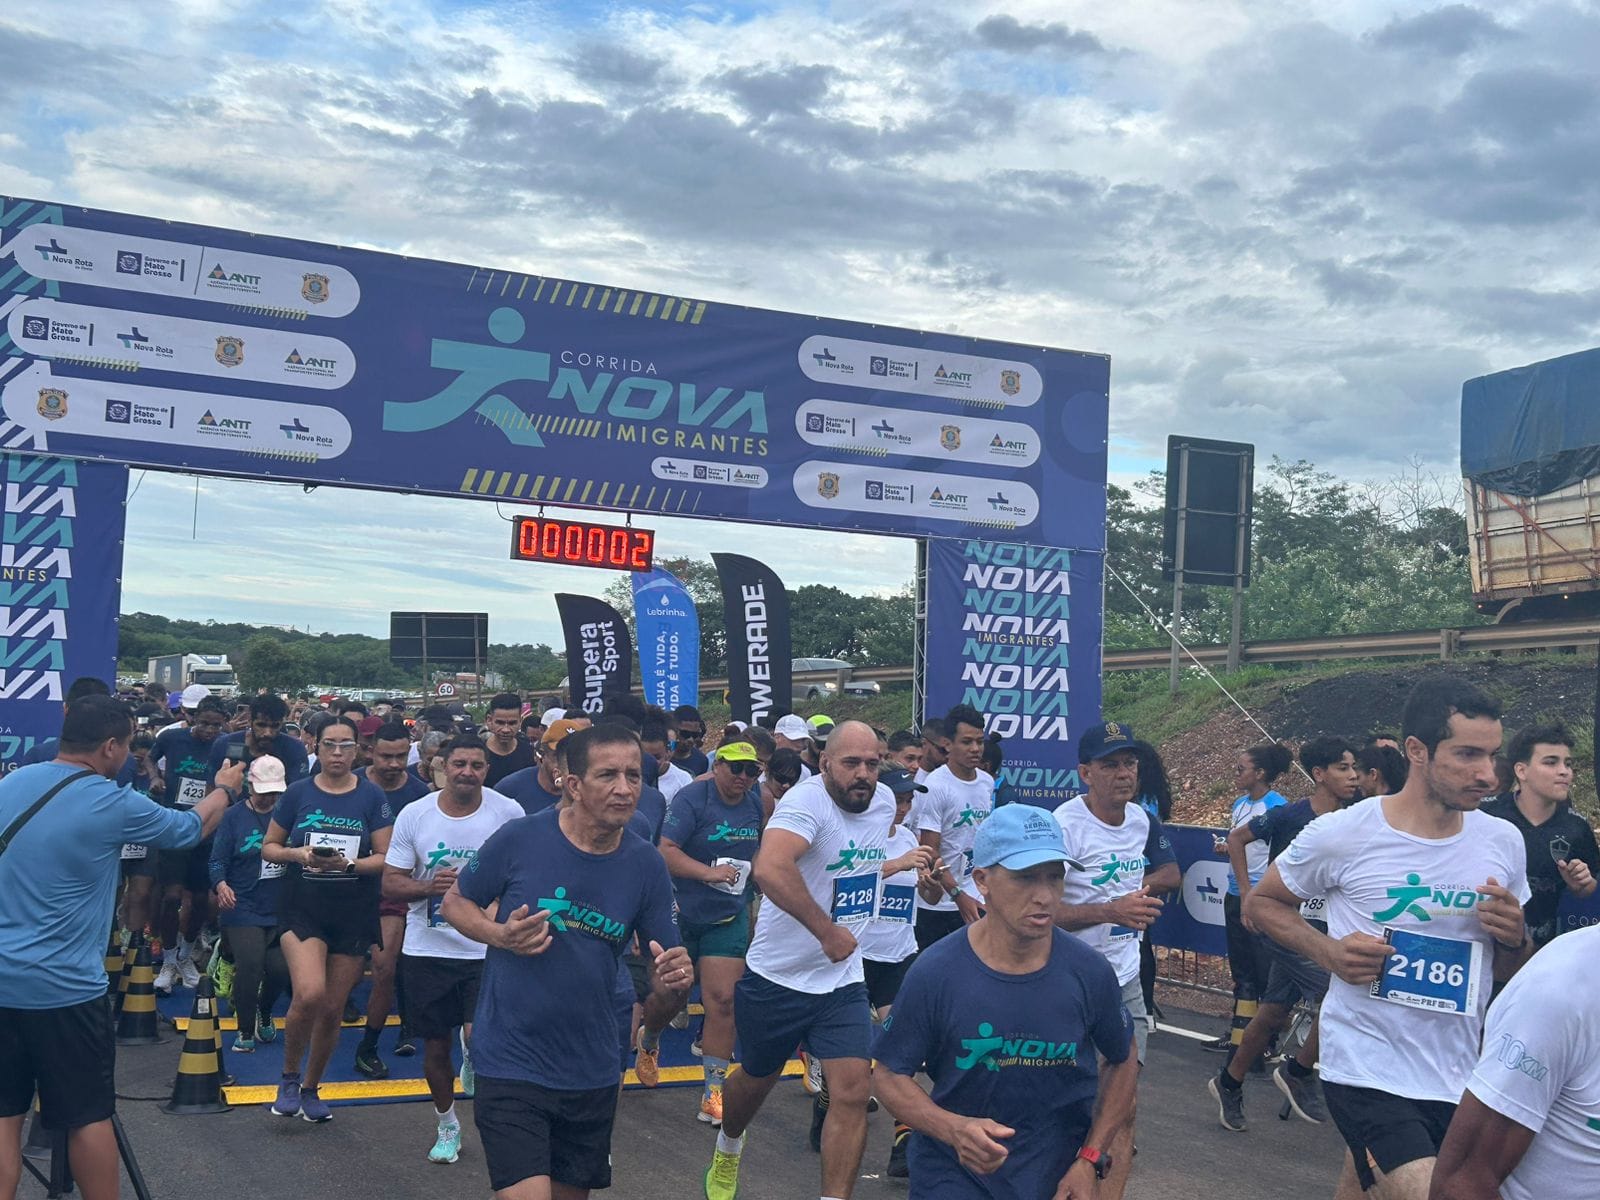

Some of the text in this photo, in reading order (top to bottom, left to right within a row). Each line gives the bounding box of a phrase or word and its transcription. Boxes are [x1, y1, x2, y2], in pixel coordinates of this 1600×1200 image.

[53, 255, 93, 267] Nova Rota
[144, 262, 165, 270] Mato
[144, 269, 172, 278] Grosso
[228, 272, 261, 285] ANTT
[51, 327, 73, 335] Mato
[51, 333, 80, 343] Grosso
[134, 343, 154, 353] Nova
[156, 346, 174, 355] Rota
[305, 357, 336, 369] ANTT
[561, 350, 657, 375] CORRIDA
[825, 361, 840, 369] Nova
[949, 371, 972, 381] ANTT
[548, 367, 768, 434] NOVA
[133, 410, 155, 418] Mato
[133, 417, 162, 426] Grosso
[219, 418, 252, 430] ANTT
[296, 433, 333, 443] Nova Rota
[607, 422, 768, 456] IMIGRANTES
[1004, 441, 1027, 450] ANTT
[944, 494, 968, 503] ANTT
[965, 540, 1071, 571] NOVA
[963, 564, 1071, 595] NOVA
[963, 588, 1070, 619] NOVA
[962, 613, 1070, 643] NOVA
[978, 633, 1055, 647] IMIGRANTES
[670, 631, 679, 668] TUDO,
[962, 638, 1069, 667] NOVA
[654, 631, 667, 710] GUA É VIDA,
[667, 673, 679, 681] É
[961, 662, 1069, 692] NOVA
[440, 685, 453, 694] 60
[961, 687, 1068, 716] NOVA
[999, 767, 1080, 789] NOVA
[183, 787, 204, 799] 423
[324, 817, 363, 828] NOVA
[837, 888, 872, 907] 2128
[880, 896, 911, 911] 2227
[1208, 895, 1222, 905] Nova
[568, 905, 625, 937] NOVA
[1388, 954, 1464, 987] 2186
[1421, 999, 1438, 1007] PRF
[1002, 1039, 1077, 1058] NOVA
[1497, 1033, 1549, 1082] 10KM
